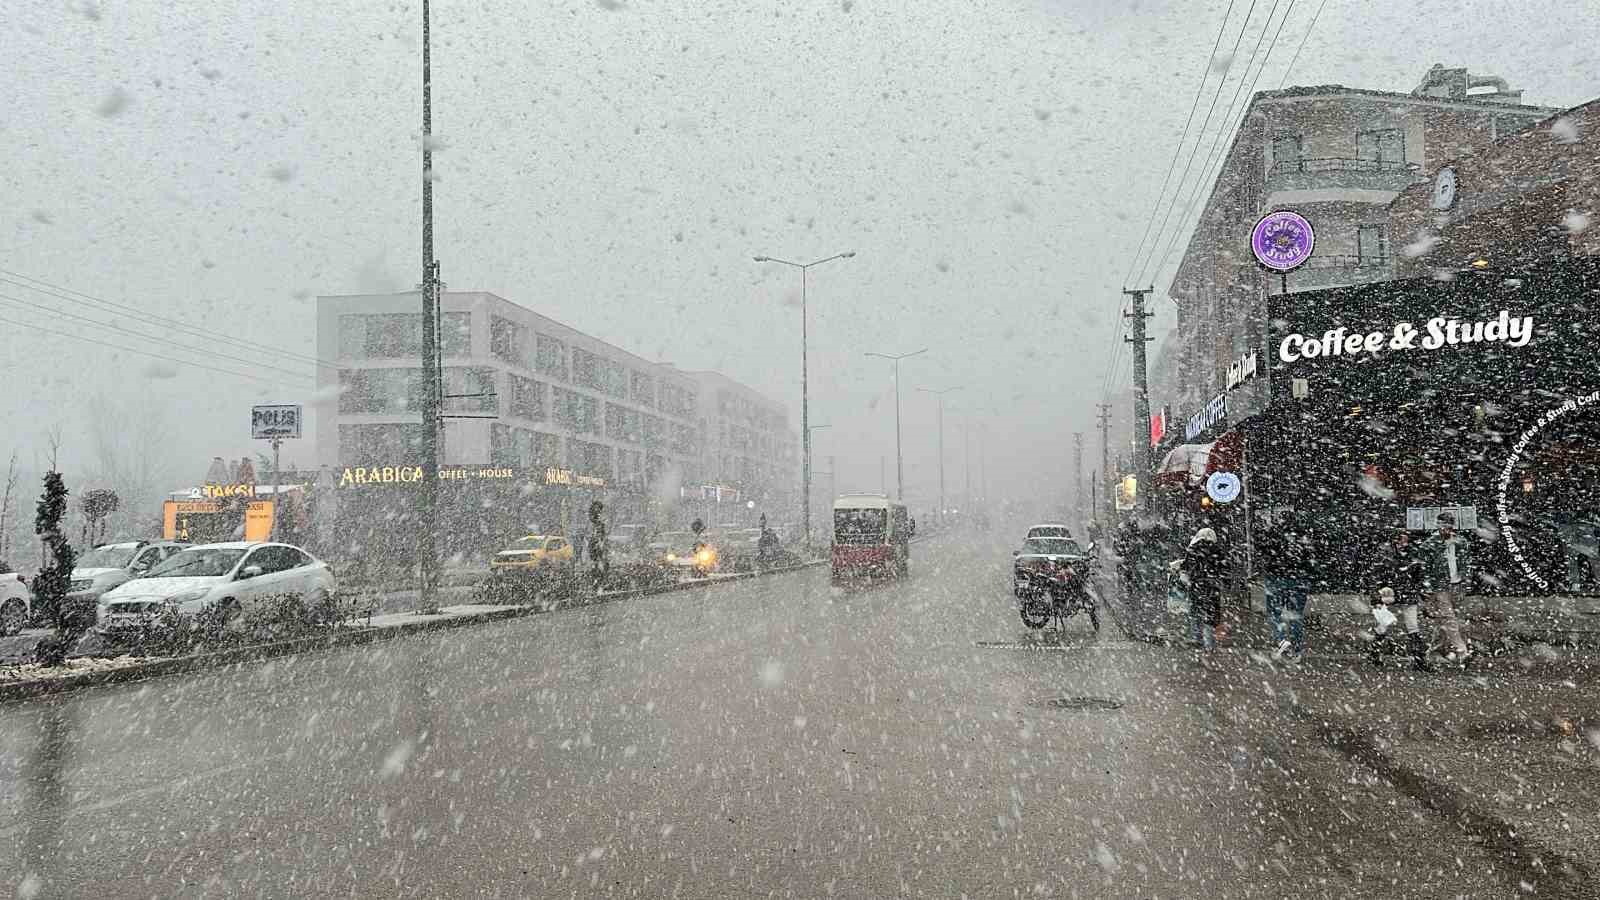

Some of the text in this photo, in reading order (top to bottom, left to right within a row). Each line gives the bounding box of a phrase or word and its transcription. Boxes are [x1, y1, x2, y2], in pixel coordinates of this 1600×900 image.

[1265, 220, 1302, 238] Coffee
[1266, 246, 1301, 260] Study
[1279, 310, 1533, 362] Coffee & Study
[1546, 400, 1577, 421] Study
[1538, 418, 1548, 427] &
[1513, 425, 1538, 453] Coffee
[339, 466, 512, 487] ARABICA OFFEE HOUSE
[1500, 453, 1520, 482] Study
[1498, 482, 1507, 491] &
[1496, 492, 1508, 523] Coffee
[1502, 525, 1519, 553] Study
[1521, 562, 1548, 588] Coffee
